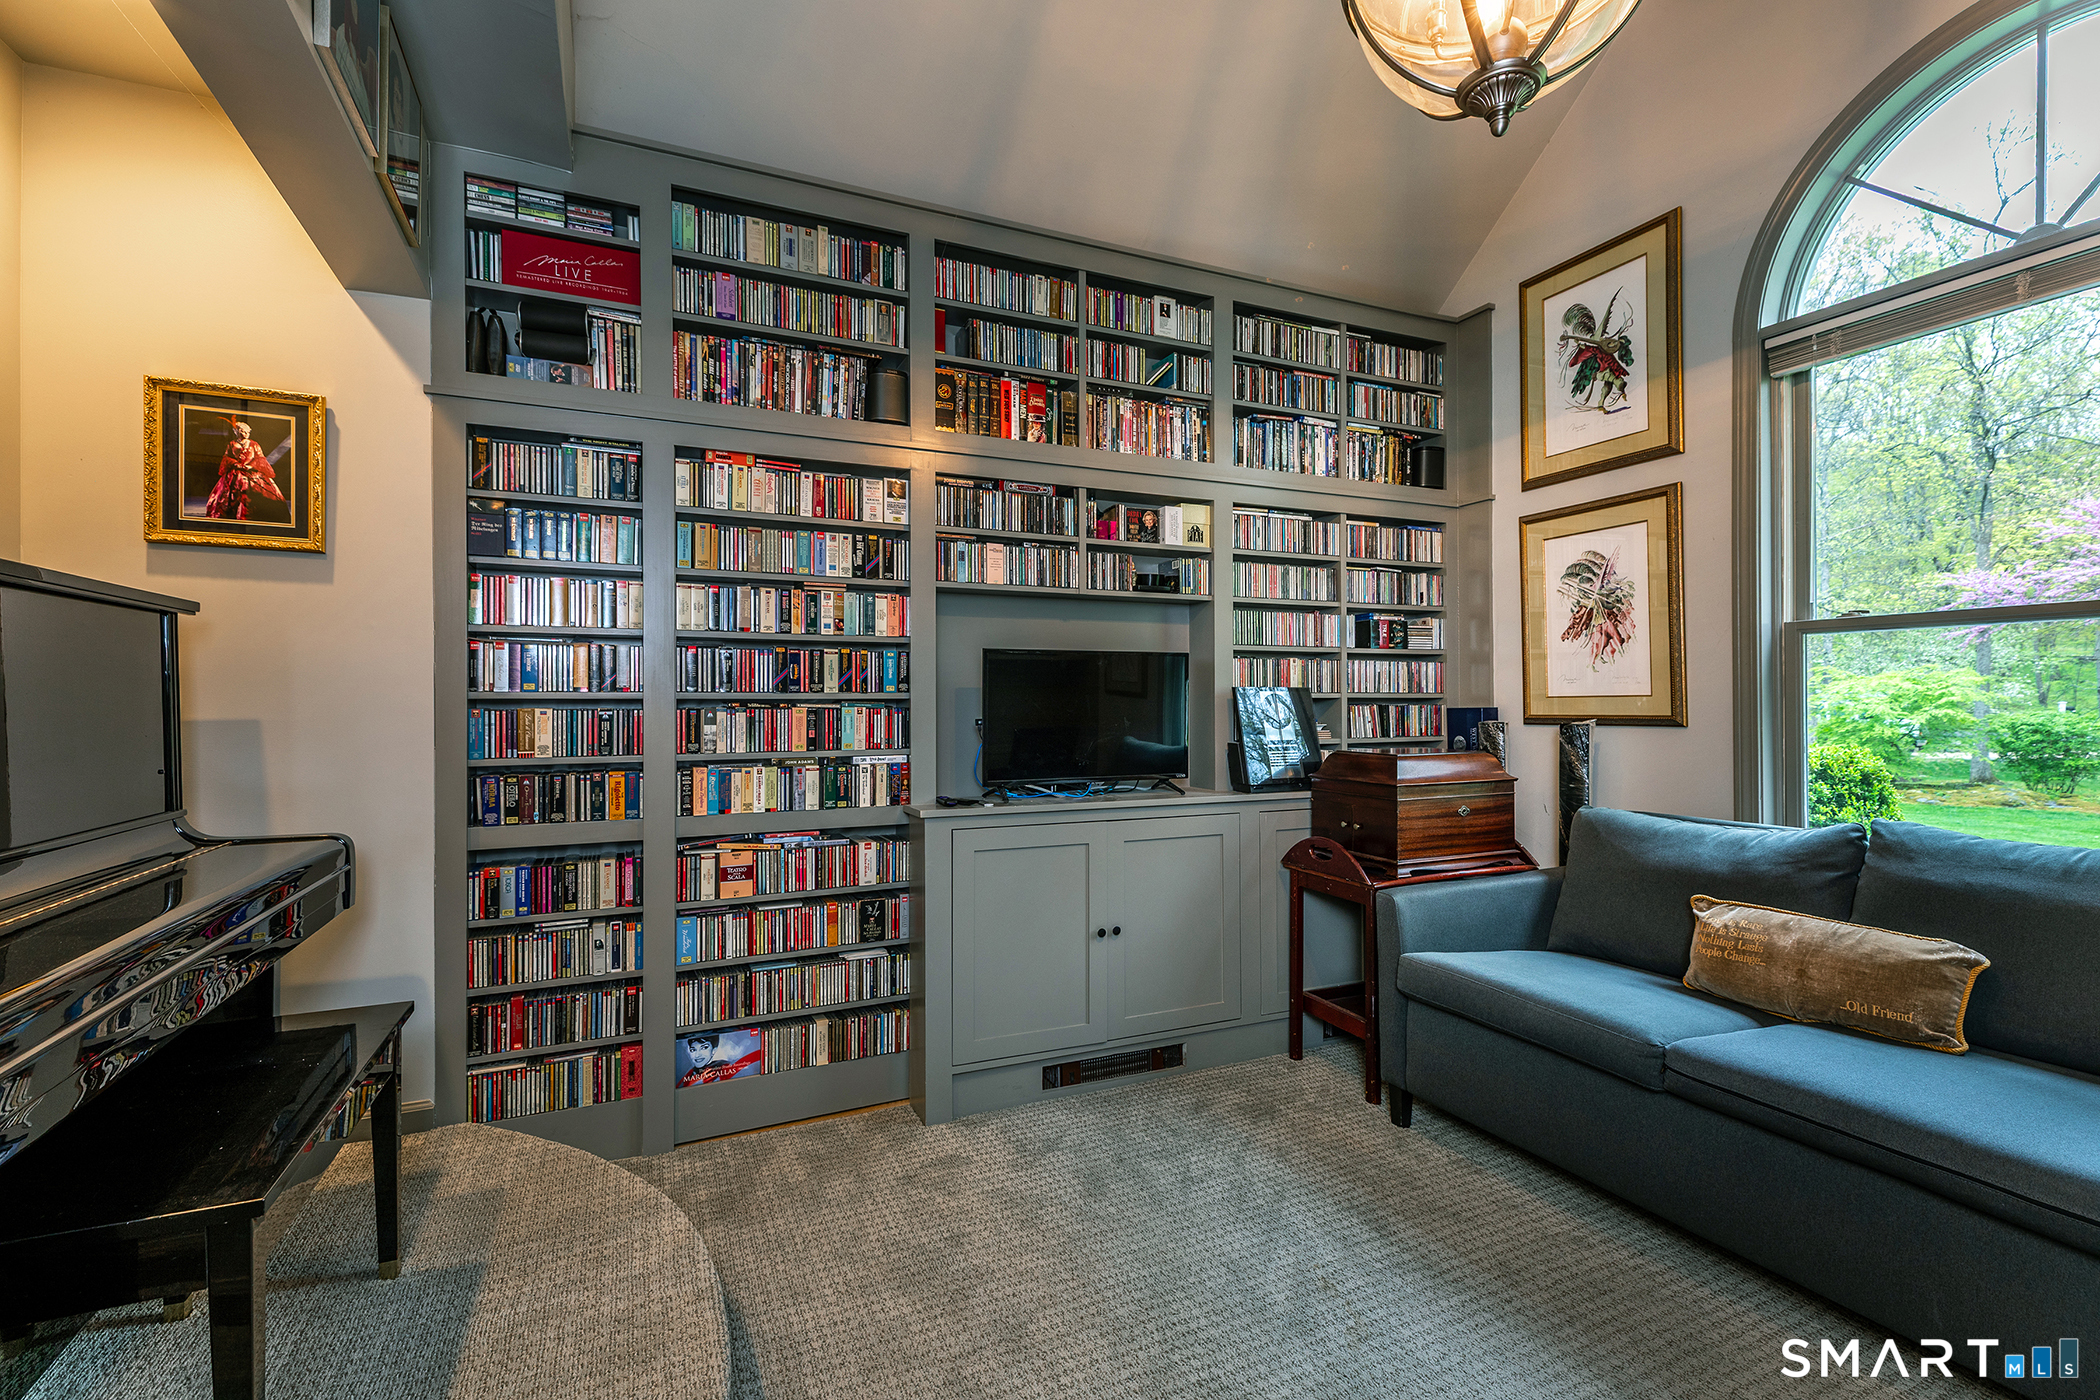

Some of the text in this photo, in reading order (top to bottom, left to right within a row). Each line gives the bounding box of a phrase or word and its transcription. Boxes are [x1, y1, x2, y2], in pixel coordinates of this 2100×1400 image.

[523, 255, 624, 267] Maria Callas
[555, 265, 592, 282] LIVE
[516, 274, 550, 284] REMASTERED
[565, 281, 599, 291] RECORDINGS
[1187, 528, 1204, 543] PIAF
[488, 784, 496, 808] NORMA
[614, 780, 622, 811] Rigoletto
[726, 866, 747, 874] TEATRO
[1700, 922, 1769, 943] Life is Strange
[1740, 920, 1764, 930] Rare
[1695, 944, 1722, 958] People
[1698, 933, 1764, 953] Nothing Lasts
[1872, 1005, 1913, 1022] Friend
[683, 1068, 736, 1083] MARIA CALLAS
